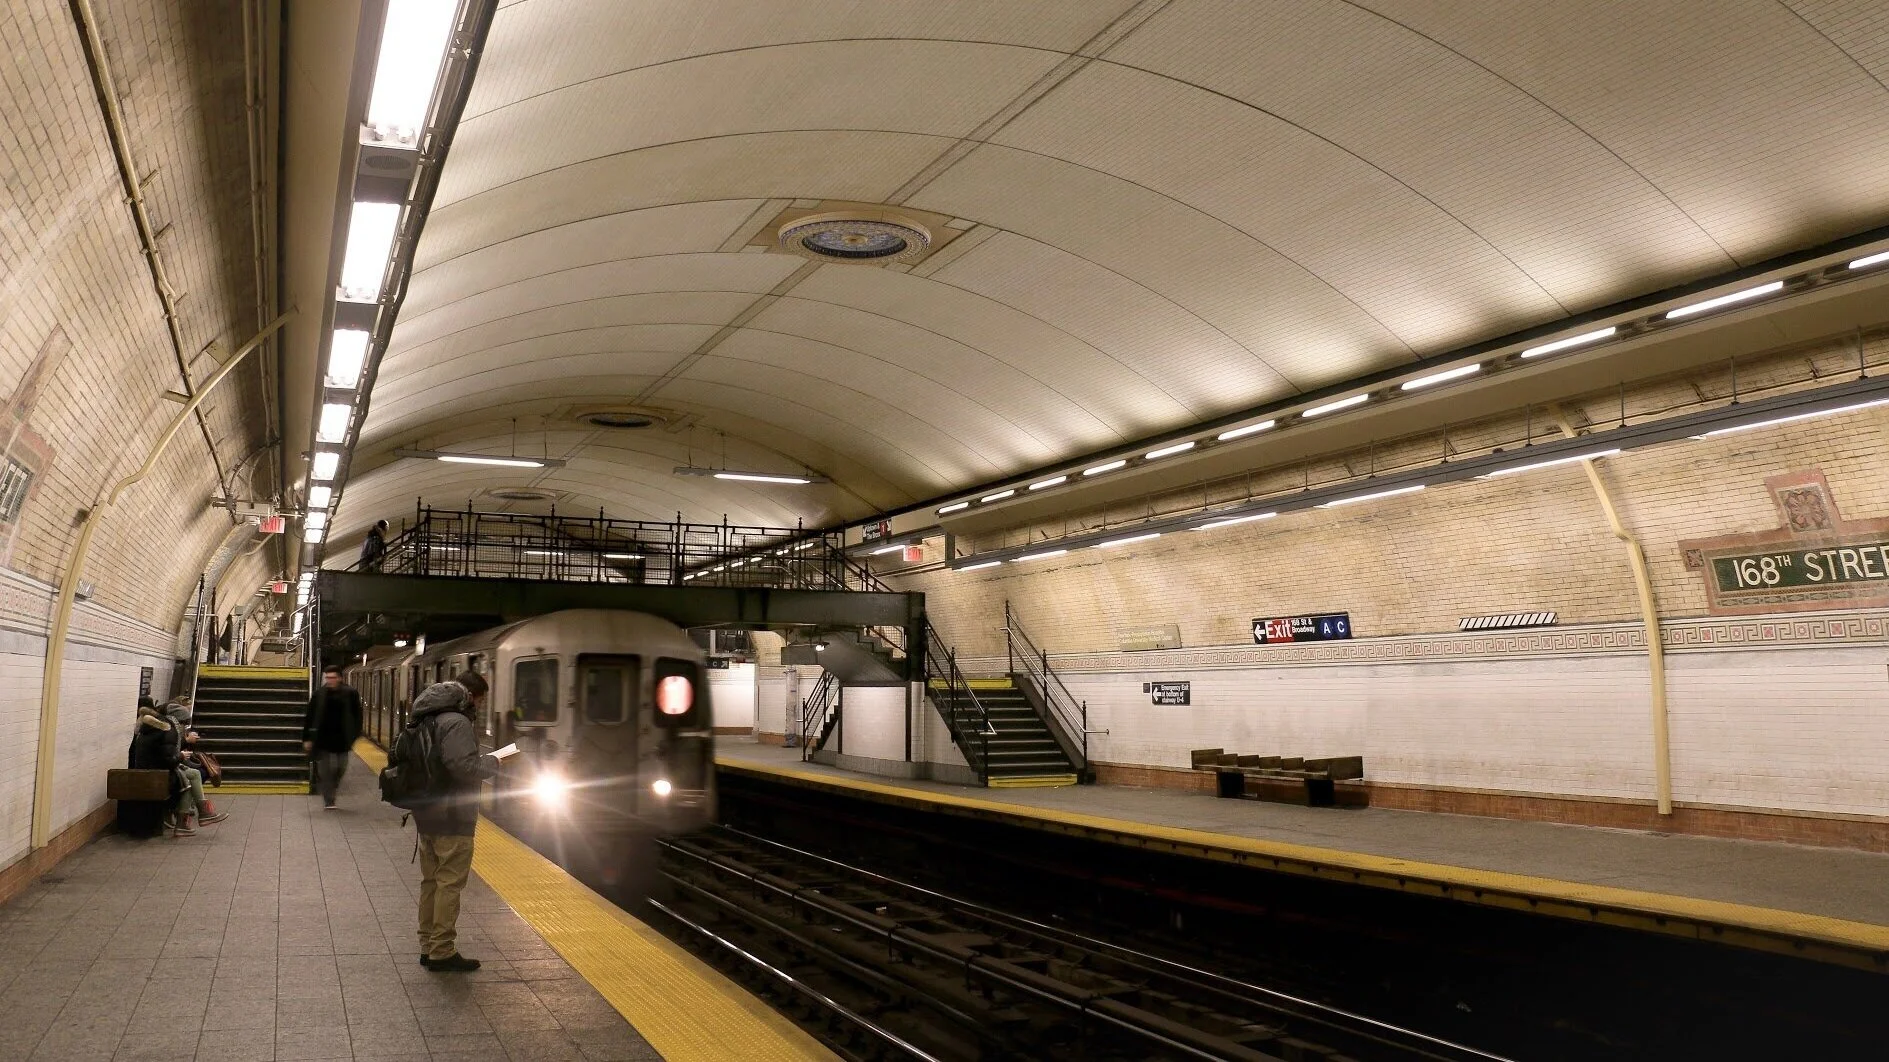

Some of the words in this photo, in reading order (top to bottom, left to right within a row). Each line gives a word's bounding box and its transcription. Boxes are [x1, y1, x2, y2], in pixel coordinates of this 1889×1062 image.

[1733, 554, 1792, 588] 168TH
[1291, 618, 1300, 627] 168
[1301, 618, 1307, 626] St
[1265, 619, 1293, 639] Exit
[1323, 622, 1331, 634] A
[1337, 621, 1345, 633] C
[1291, 625, 1316, 634] Broadway
[1161, 684, 1181, 692] Emergency
